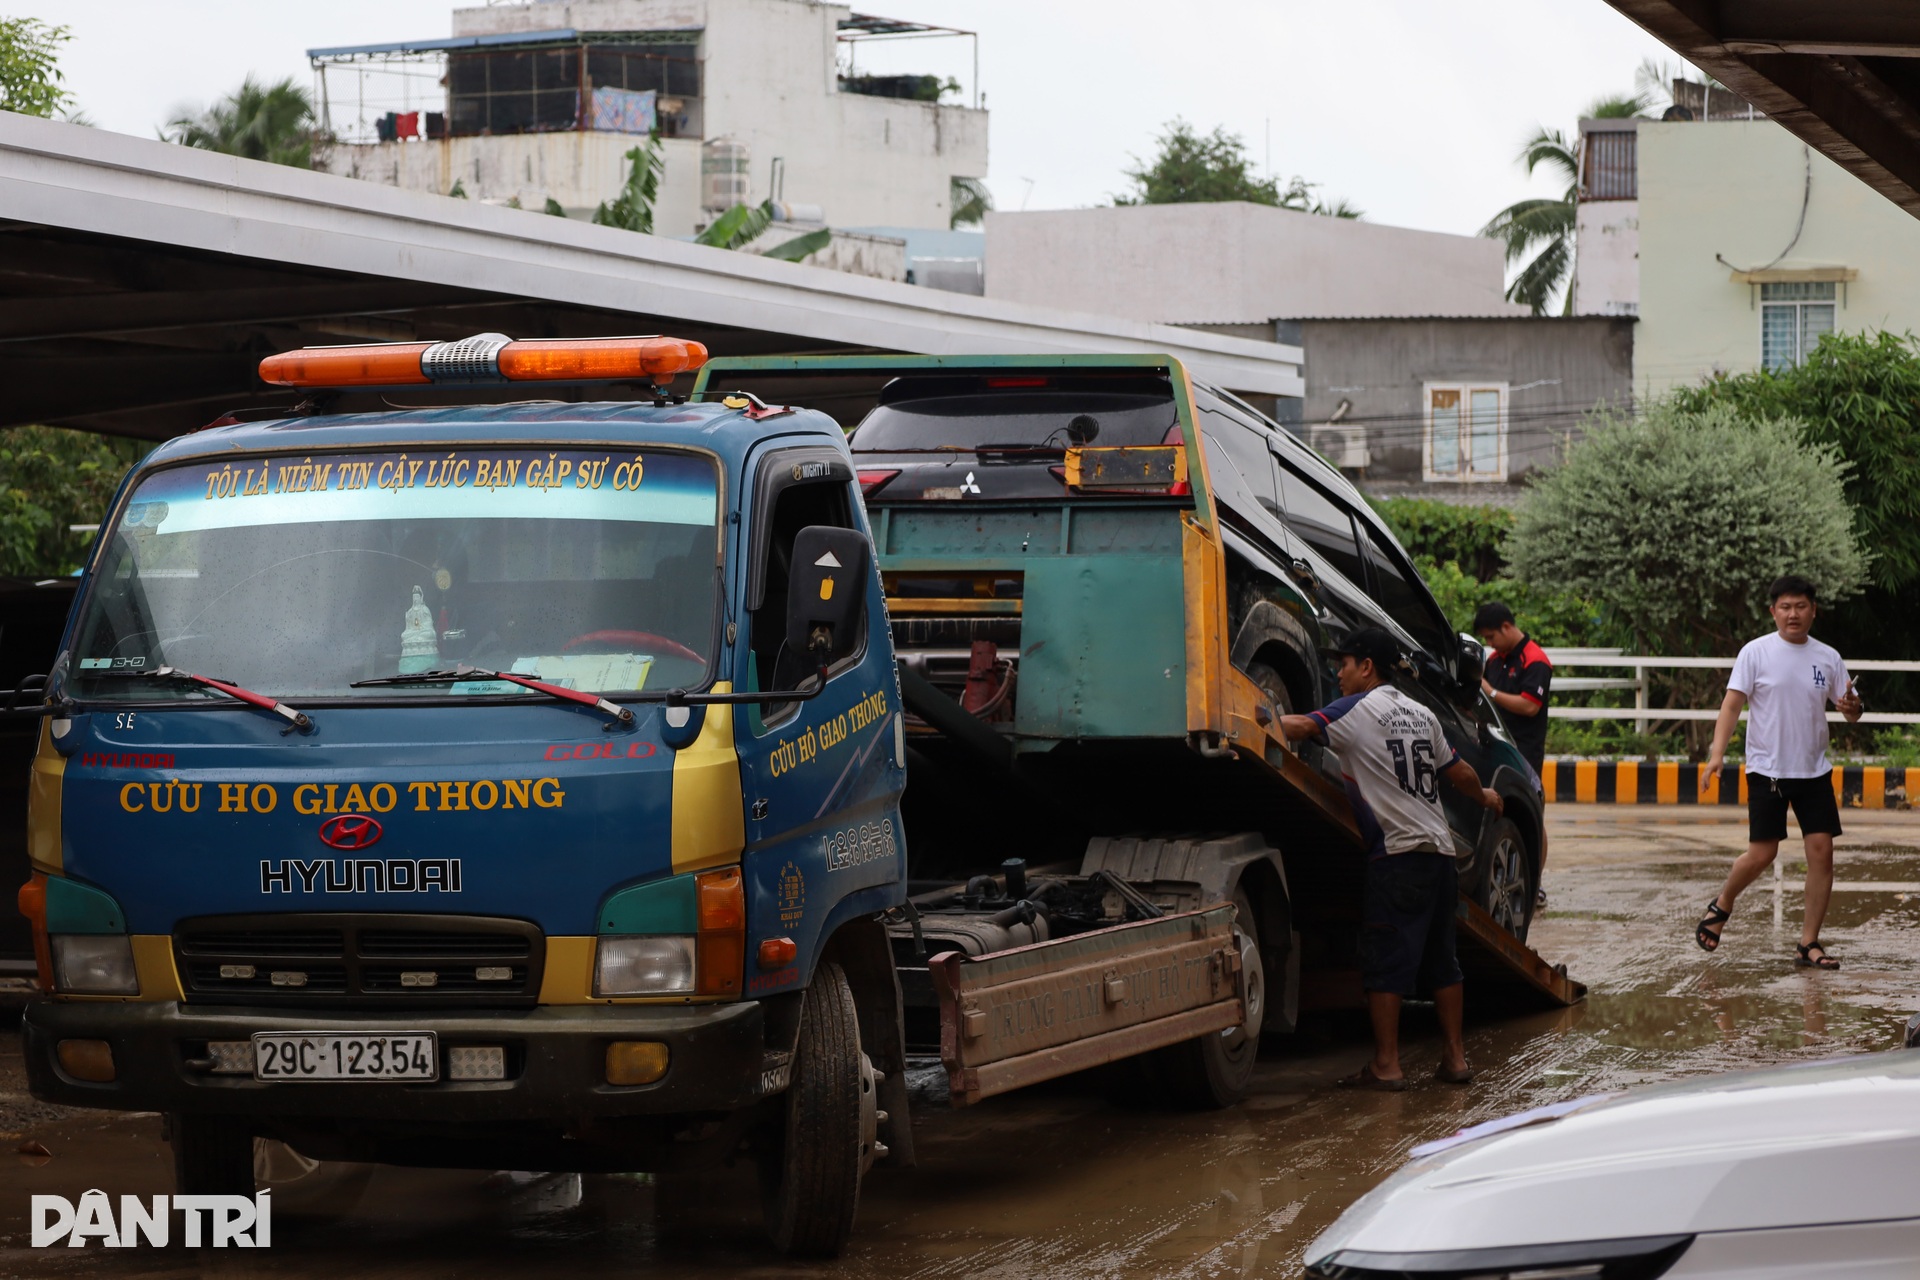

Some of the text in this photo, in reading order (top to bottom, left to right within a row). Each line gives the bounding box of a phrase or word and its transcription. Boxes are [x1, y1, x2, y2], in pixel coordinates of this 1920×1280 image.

[205, 464, 241, 499] TÔI
[336, 462, 374, 490] TIN
[377, 453, 423, 494] CẬY
[424, 452, 470, 488] LÚC
[473, 459, 522, 493] BẠN
[525, 452, 572, 493] GẶP
[802, 462, 824, 478] MIGHTY
[1812, 665, 1826, 686] LA
[81, 752, 176, 769] HYUNDAI
[544, 741, 657, 761] GOLD
[770, 738, 796, 778] CỨU
[797, 725, 817, 764] HỘ
[818, 714, 847, 750] GIAO
[1385, 739, 1438, 804] 16
[217, 783, 278, 813] HO
[292, 782, 398, 815] GIAO
[407, 777, 566, 811] THONG
[260, 858, 462, 894] HYUNDAI
[992, 992, 1055, 1041] TRUNG
[1062, 976, 1101, 1023] TÂM
[261, 1041, 429, 1075] 29C-123.54
